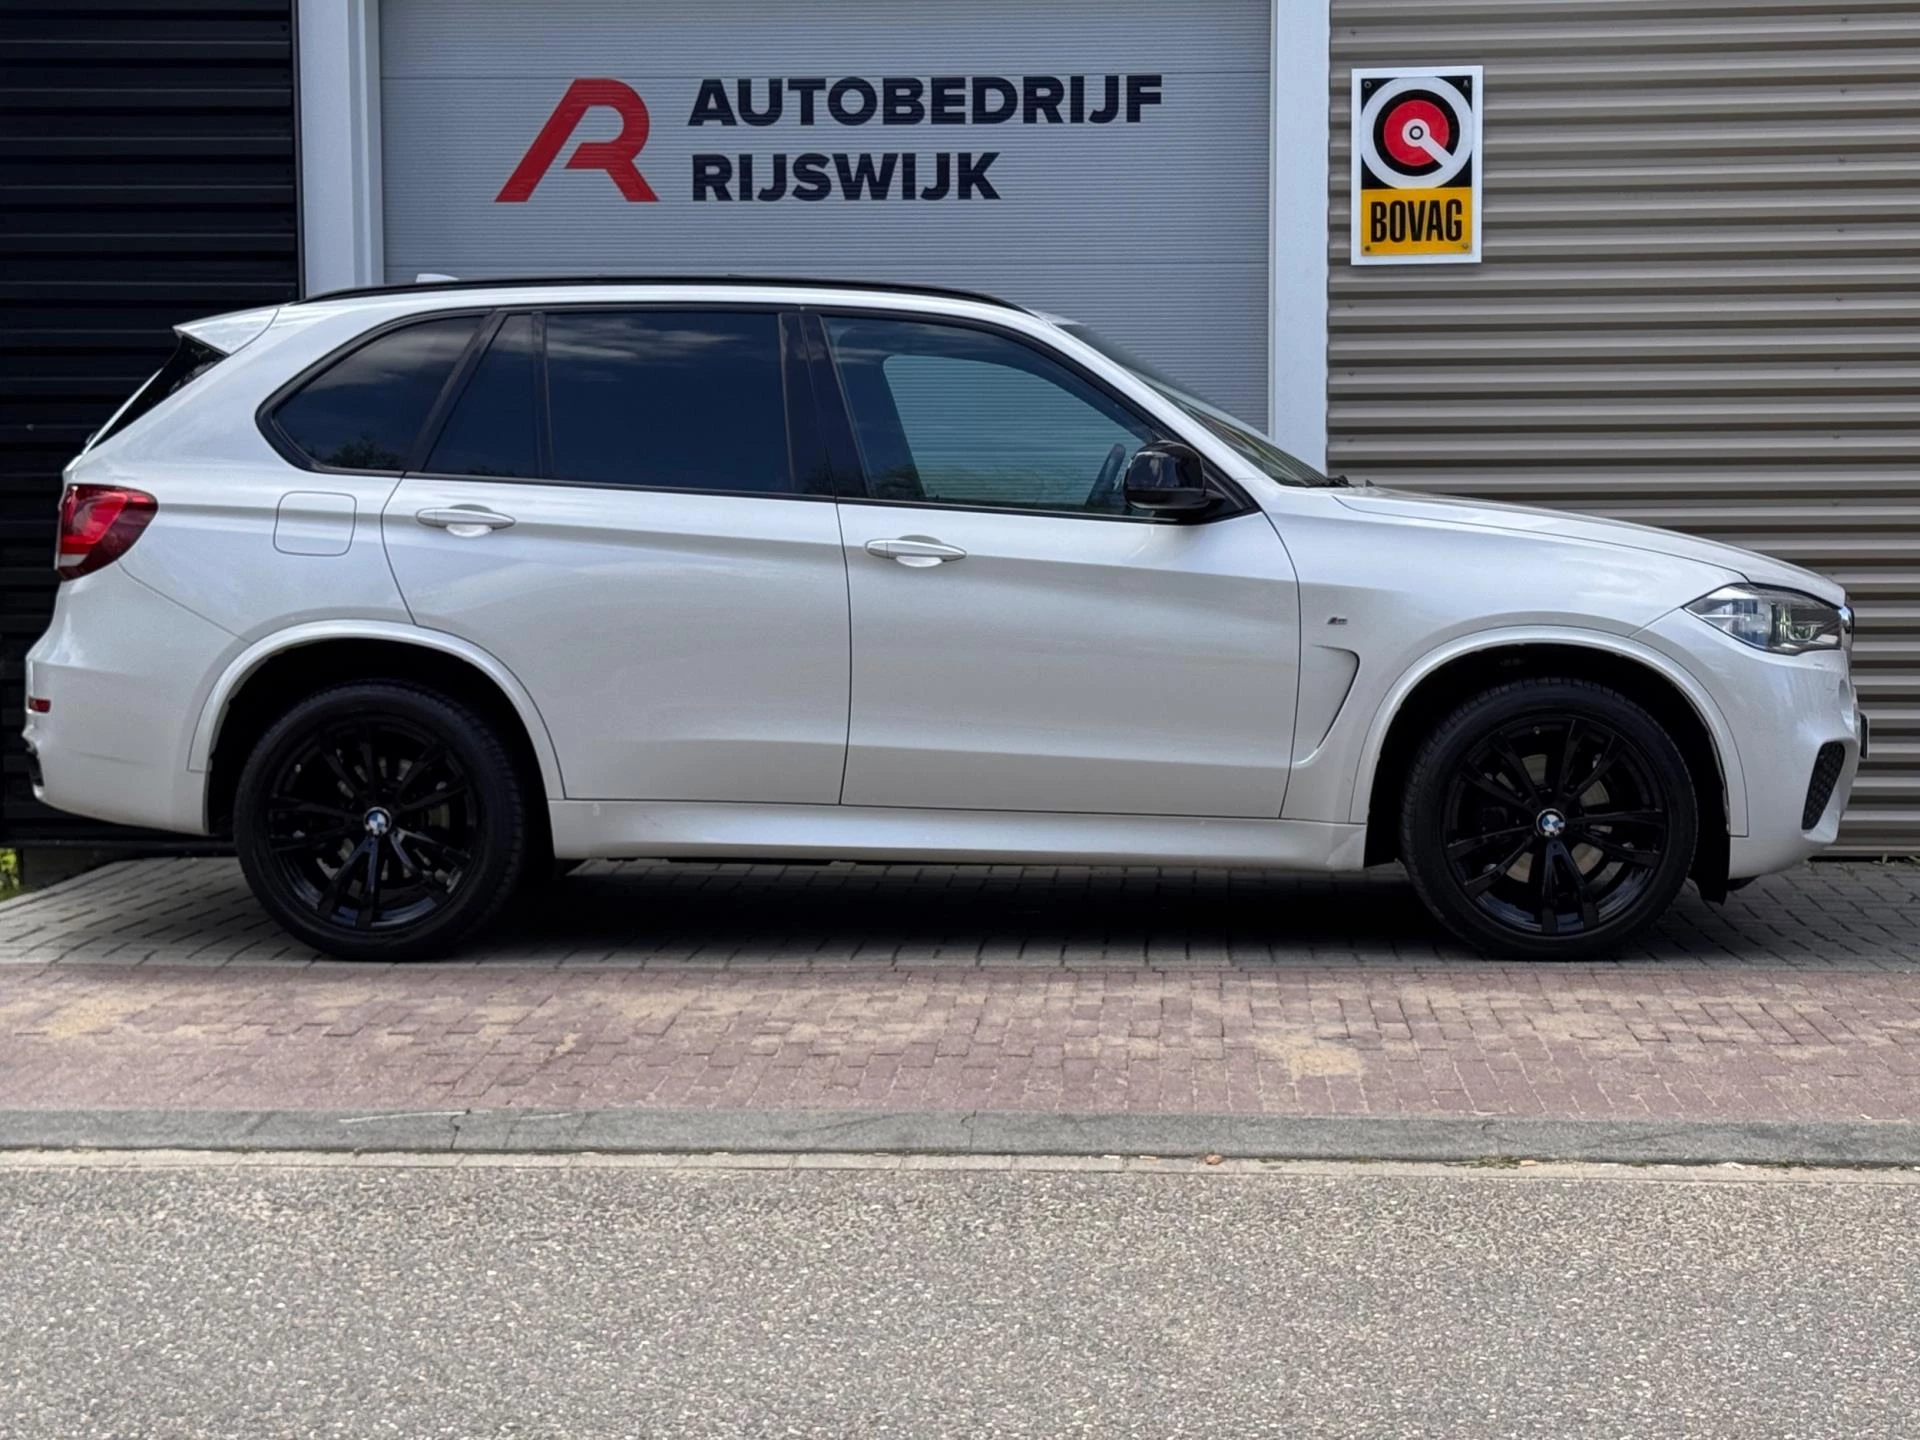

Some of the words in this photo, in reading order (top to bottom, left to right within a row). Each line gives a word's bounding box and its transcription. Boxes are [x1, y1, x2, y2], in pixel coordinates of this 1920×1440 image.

[687, 75, 1162, 126] AUTOBEDRIJF
[692, 151, 1001, 202] RIJSWIJK
[1371, 199, 1463, 243] BOVAG
